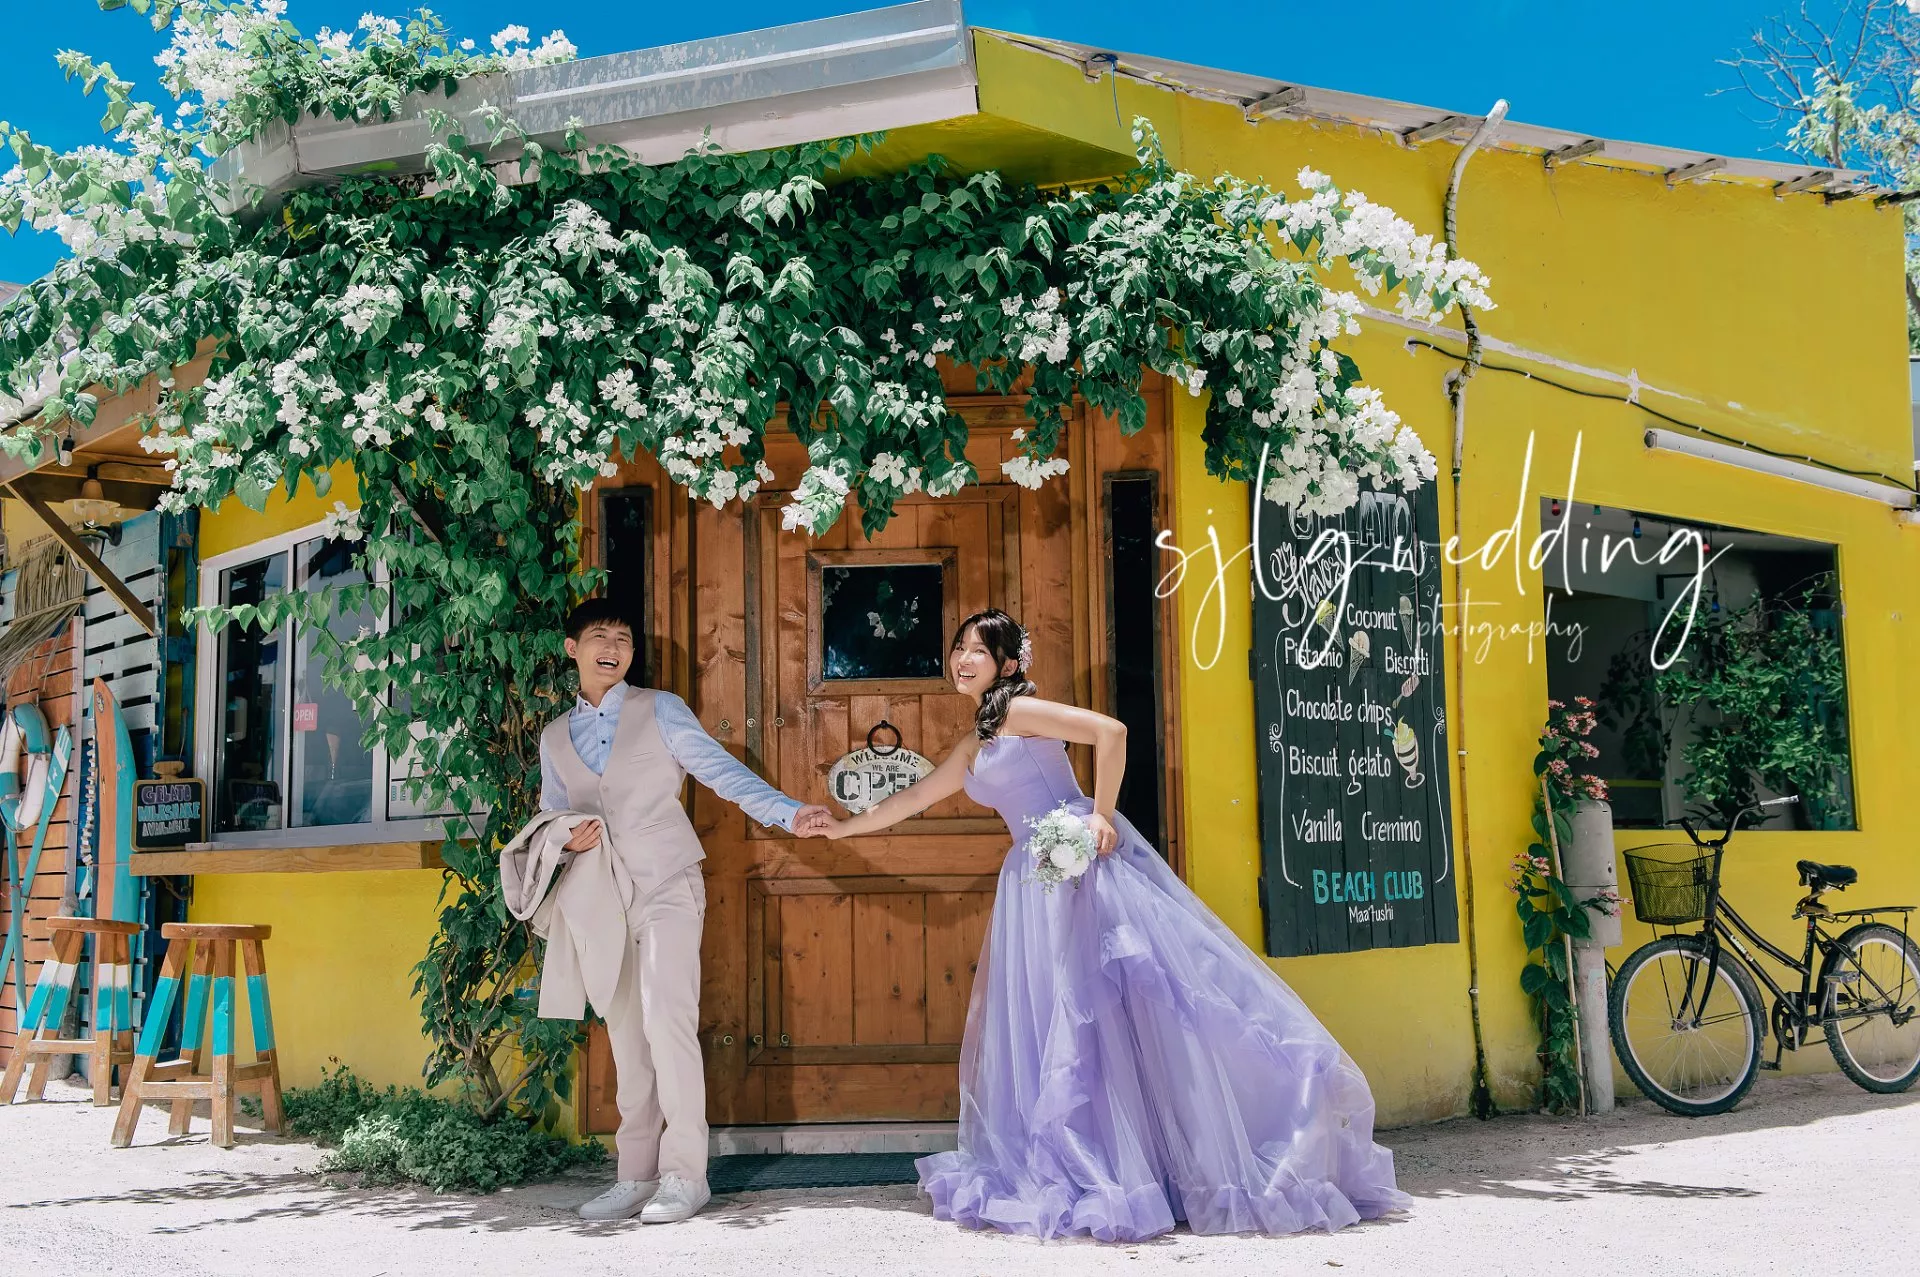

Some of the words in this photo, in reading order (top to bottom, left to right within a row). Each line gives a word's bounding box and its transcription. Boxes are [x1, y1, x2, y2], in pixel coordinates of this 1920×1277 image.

[1346, 602, 1398, 631] Coconut
[1285, 637, 1343, 669] Pistachio
[1385, 646, 1430, 676] Biscotti
[295, 709, 314, 721] OPEN
[1286, 684, 1353, 721] Chocolate
[1357, 688, 1393, 735] chips
[886, 764, 900, 772] ARE
[1289, 745, 1342, 778] Biscuit
[1347, 747, 1391, 796] gelato
[141, 784, 192, 805] GELATO
[138, 801, 201, 822] MILKSHAKE
[1292, 808, 1342, 843] Vanilla
[1361, 811, 1422, 843] Cremino
[142, 818, 191, 837] AVAILABLE
[1312, 869, 1376, 905] BEACH
[1383, 870, 1424, 900] CLUB
[1349, 903, 1394, 924] Maafushi
